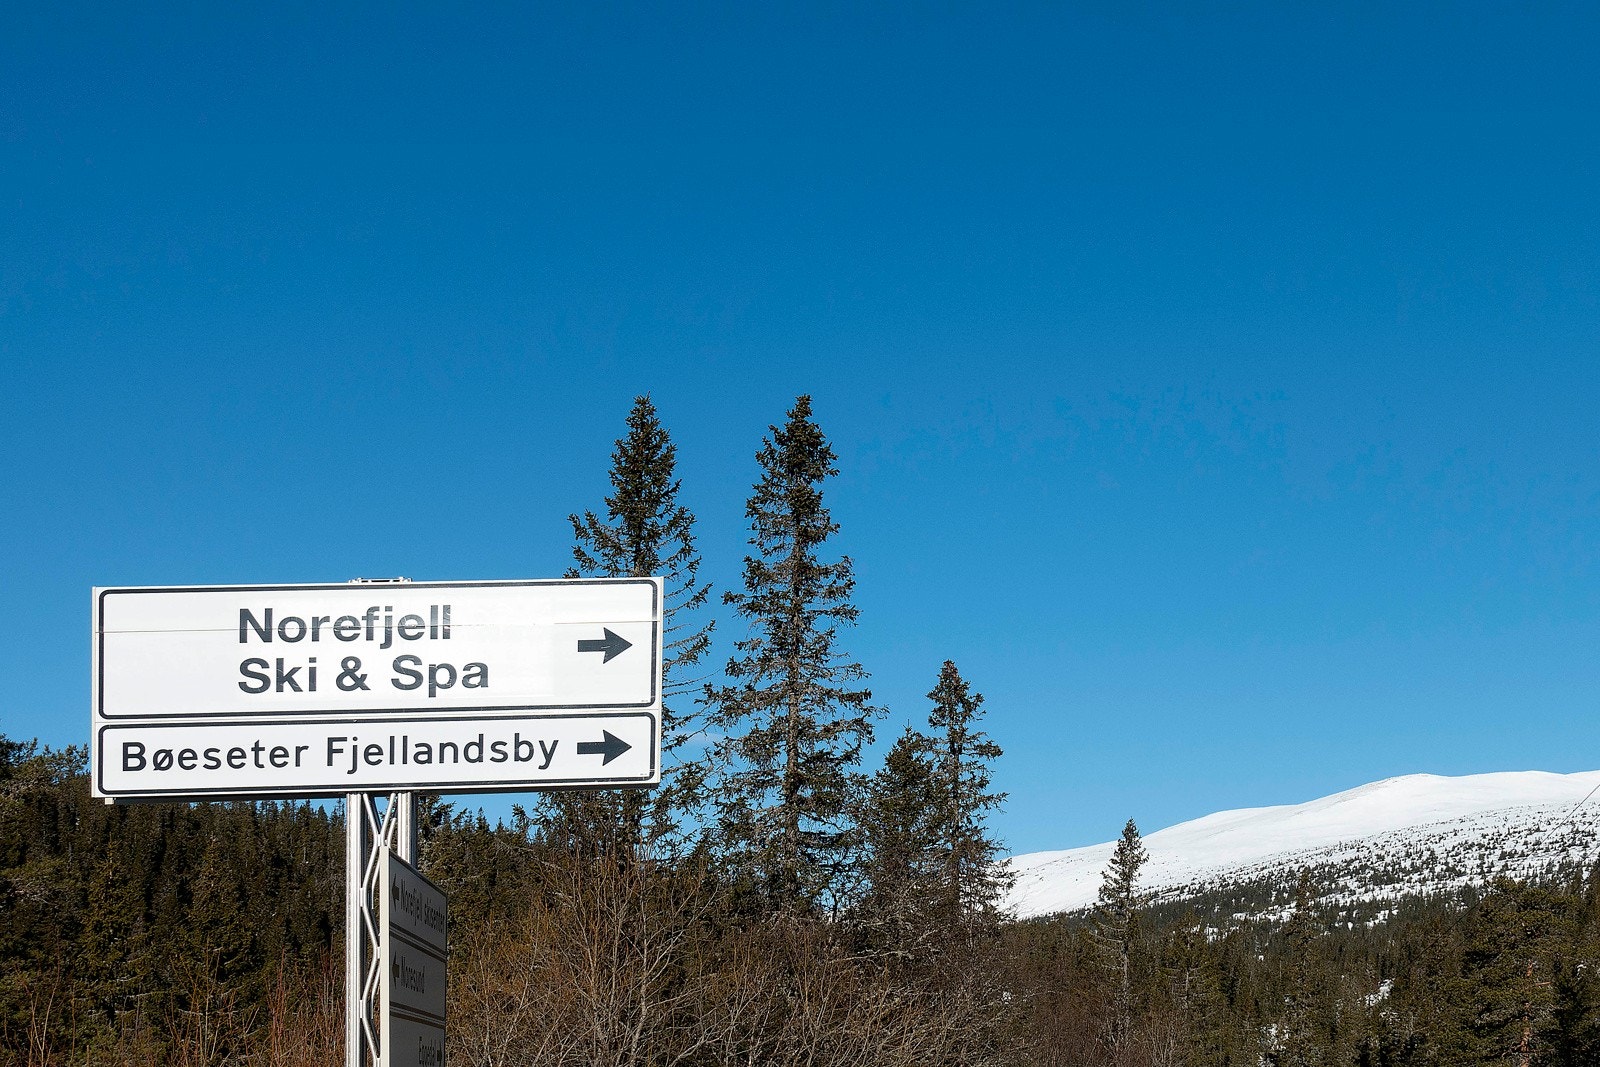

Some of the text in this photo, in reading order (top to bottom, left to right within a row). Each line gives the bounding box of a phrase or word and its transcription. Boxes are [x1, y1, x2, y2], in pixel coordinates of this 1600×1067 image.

[239, 605, 451, 649] Norefjell
[238, 654, 489, 698] Ski & Spa
[122, 733, 559, 775] Bøeseter Fjellandsby
